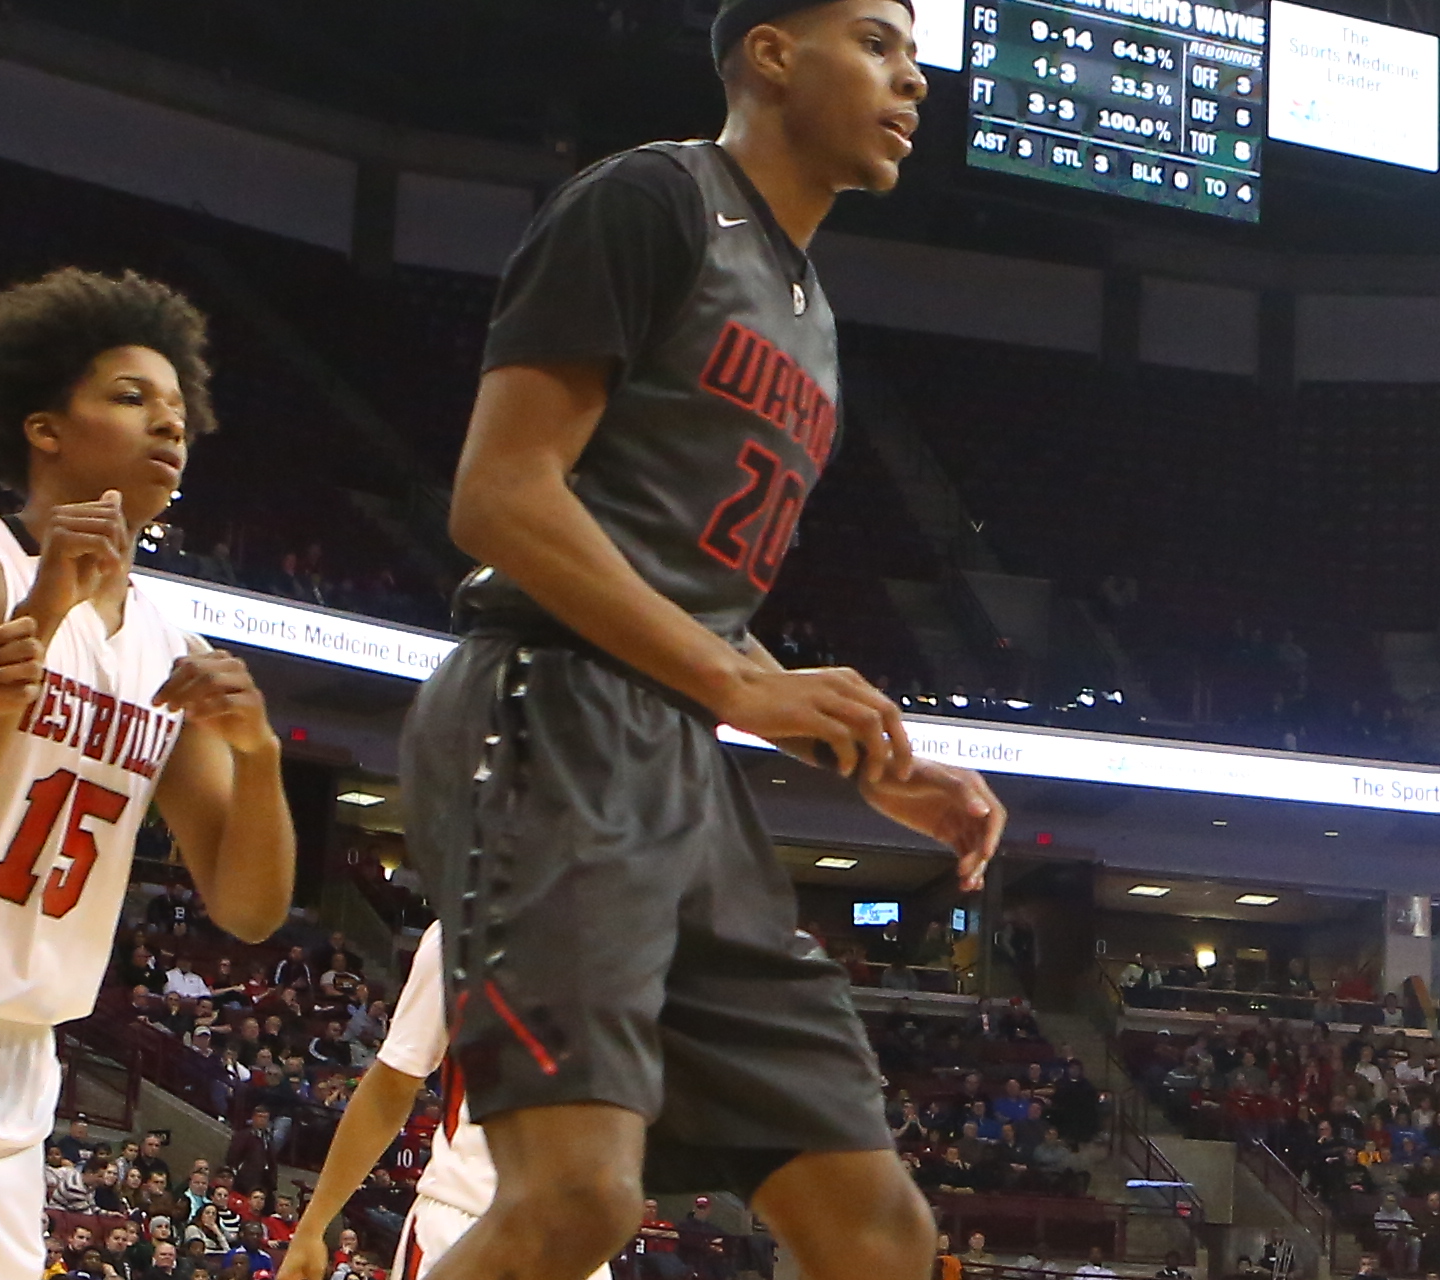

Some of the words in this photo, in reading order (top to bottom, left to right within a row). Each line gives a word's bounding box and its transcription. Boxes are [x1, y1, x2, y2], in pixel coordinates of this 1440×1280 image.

[974, 6, 998, 34] FG
[1112, 40, 1174, 70] 64.3%
[1194, 3, 1266, 45] WAYNE
[1343, 28, 1370, 47] The
[972, 41, 997, 69] 3P
[1033, 57, 1077, 84] 1-3
[1111, 75, 1173, 106] 33.3%
[1189, 42, 1264, 69] REBOUNDS
[1289, 37, 1341, 62] Sports
[1348, 51, 1419, 80] Medicine
[1192, 64, 1219, 90] OFF
[1236, 74, 1251, 95] 3
[1327, 68, 1381, 92] Leader
[972, 78, 995, 105] FT
[1028, 93, 1076, 120] 3-3
[1099, 109, 1172, 142] 100.0%
[1191, 98, 1218, 123] DEF
[1190, 130, 1217, 156] TOT
[1235, 141, 1251, 162] 8
[973, 131, 1006, 153] AST
[1018, 139, 1033, 159] 3
[1052, 147, 1083, 169] STL
[1094, 155, 1109, 173] 3
[1131, 163, 1163, 185] BLK
[1204, 178, 1228, 198] TO
[1236, 184, 1252, 203] 4
[698, 438, 806, 593] 20
[191, 600, 226, 625] The
[234, 608, 297, 640] Sports
[304, 625, 390, 660] Medicine
[397, 644, 443, 671] Lead
[957, 738, 1024, 762] Leader
[1353, 777, 1384, 797] The
